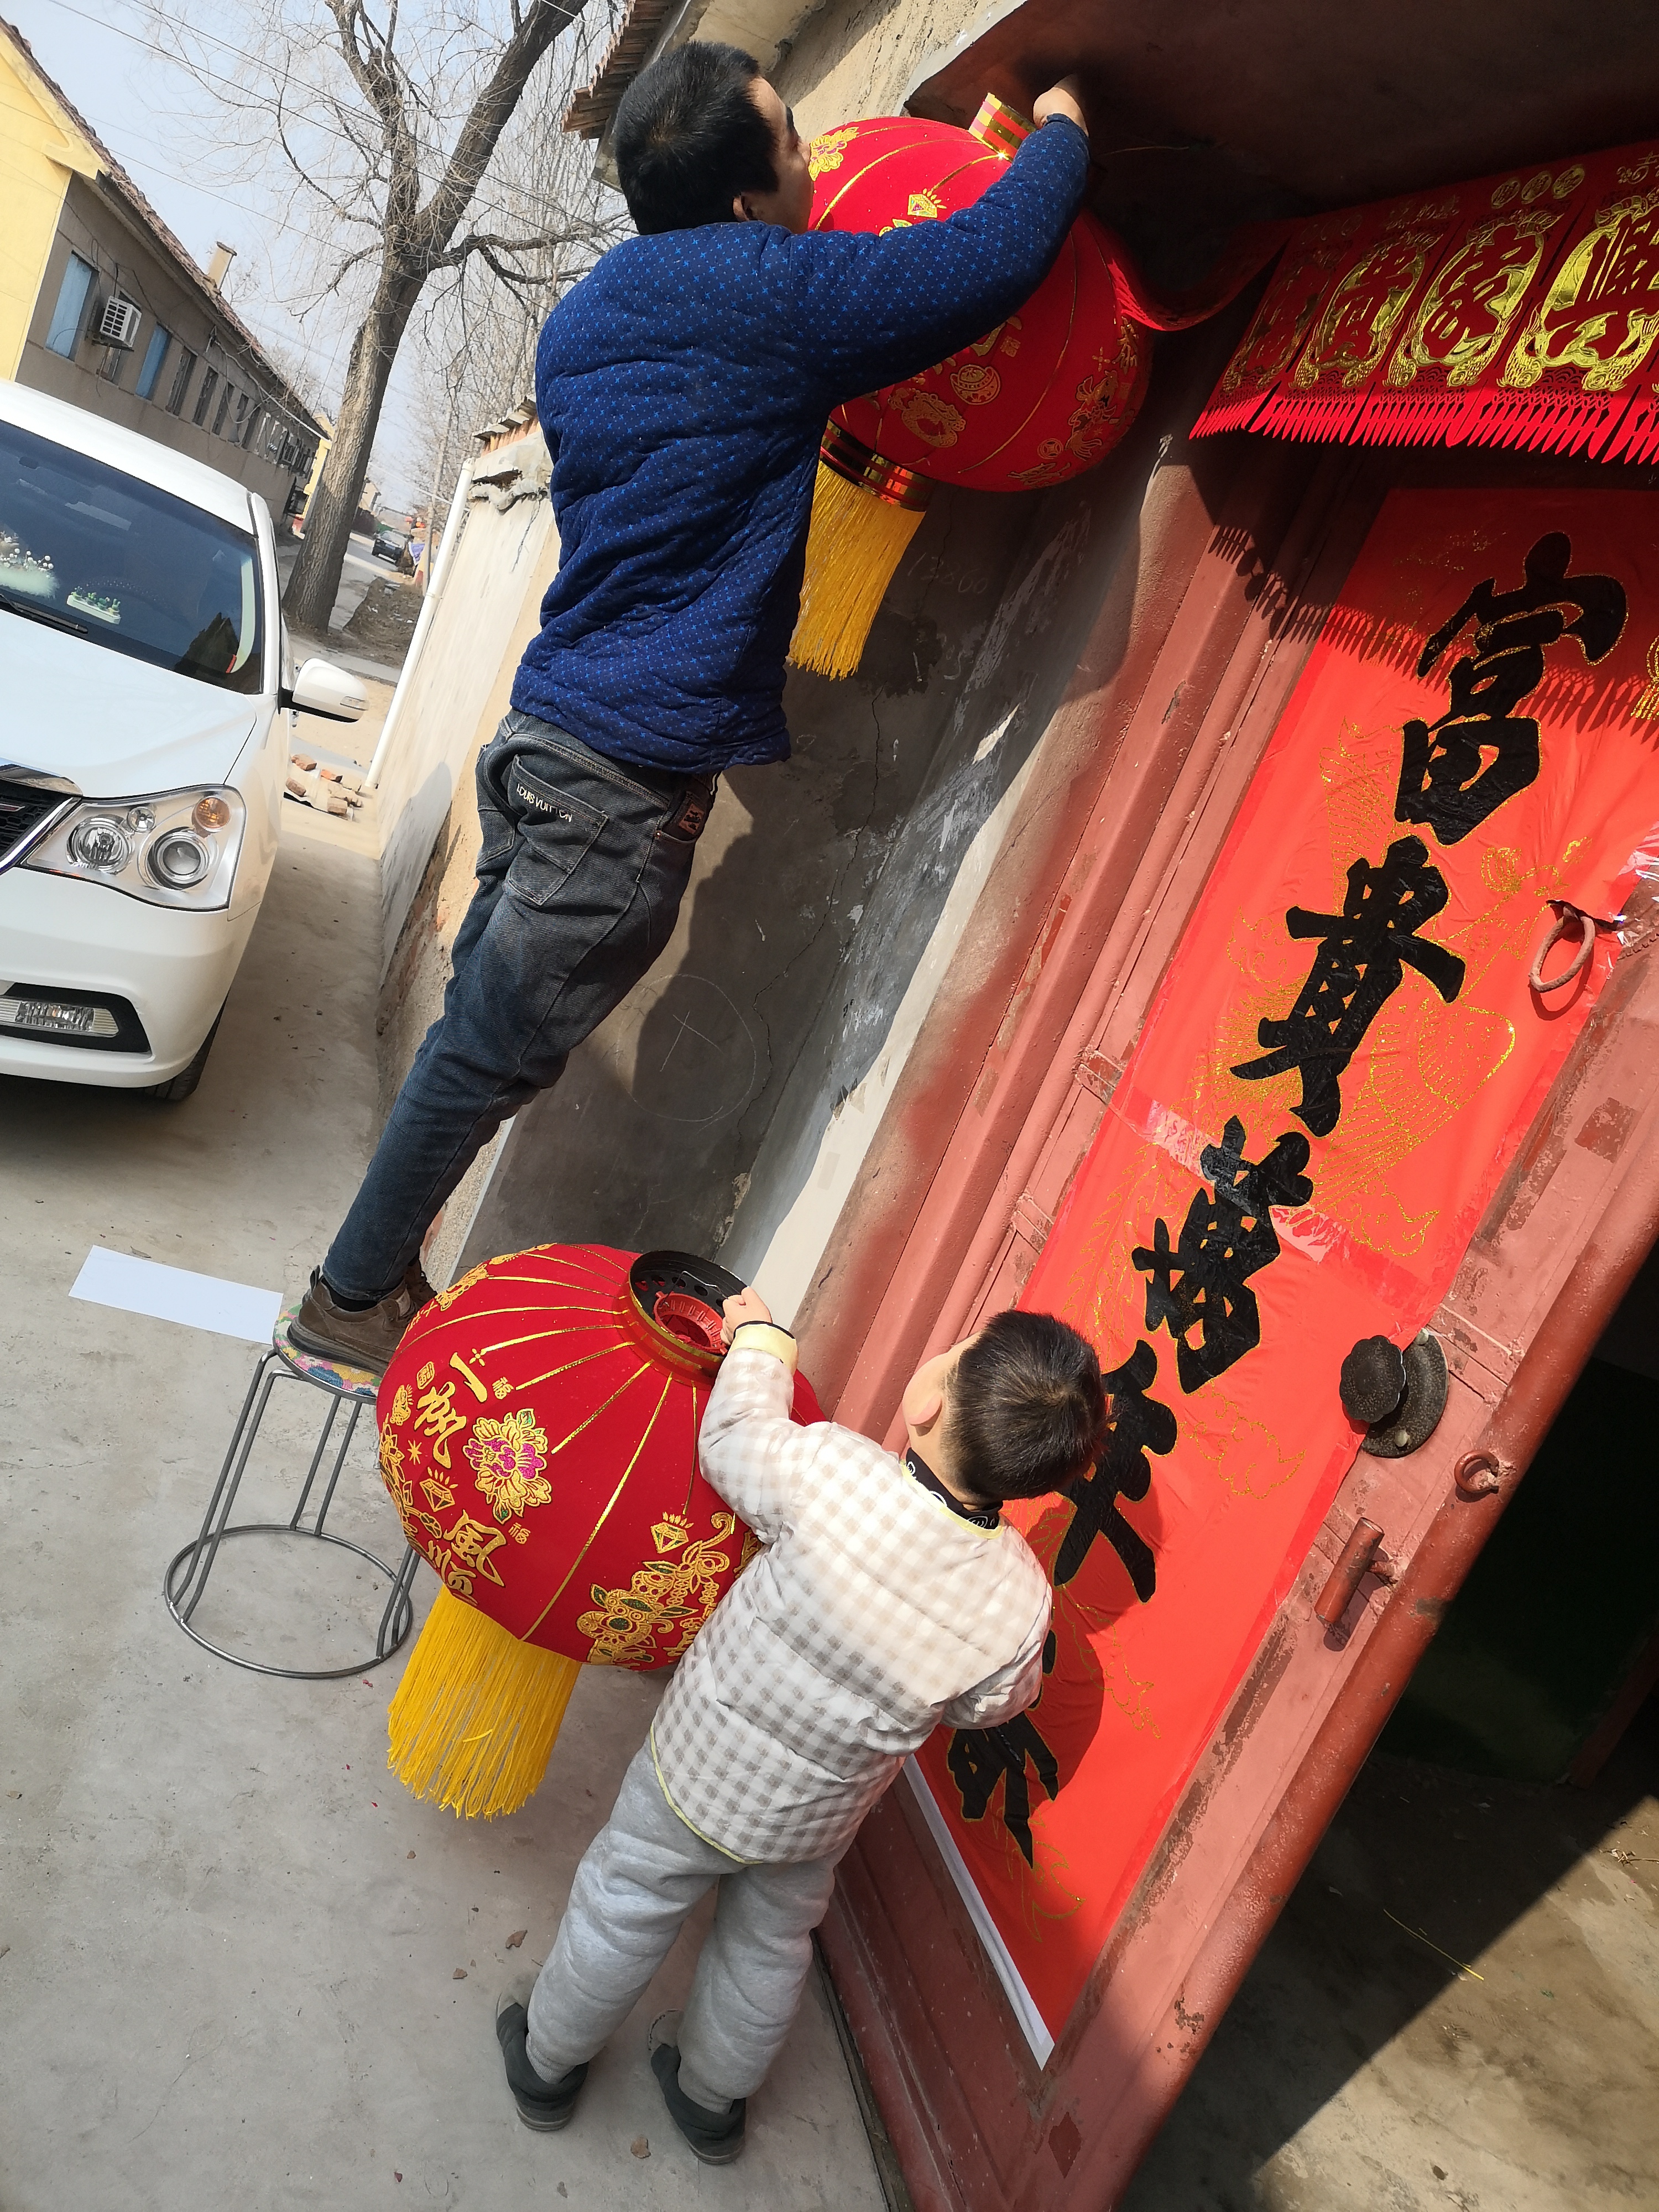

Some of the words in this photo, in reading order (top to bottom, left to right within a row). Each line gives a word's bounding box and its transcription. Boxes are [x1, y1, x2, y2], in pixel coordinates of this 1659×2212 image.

[1000, 335, 1021, 358] 福
[516, 783, 535, 804] LOUIS
[492, 1376, 514, 1400] 福
[508, 1522, 531, 1545] 福
